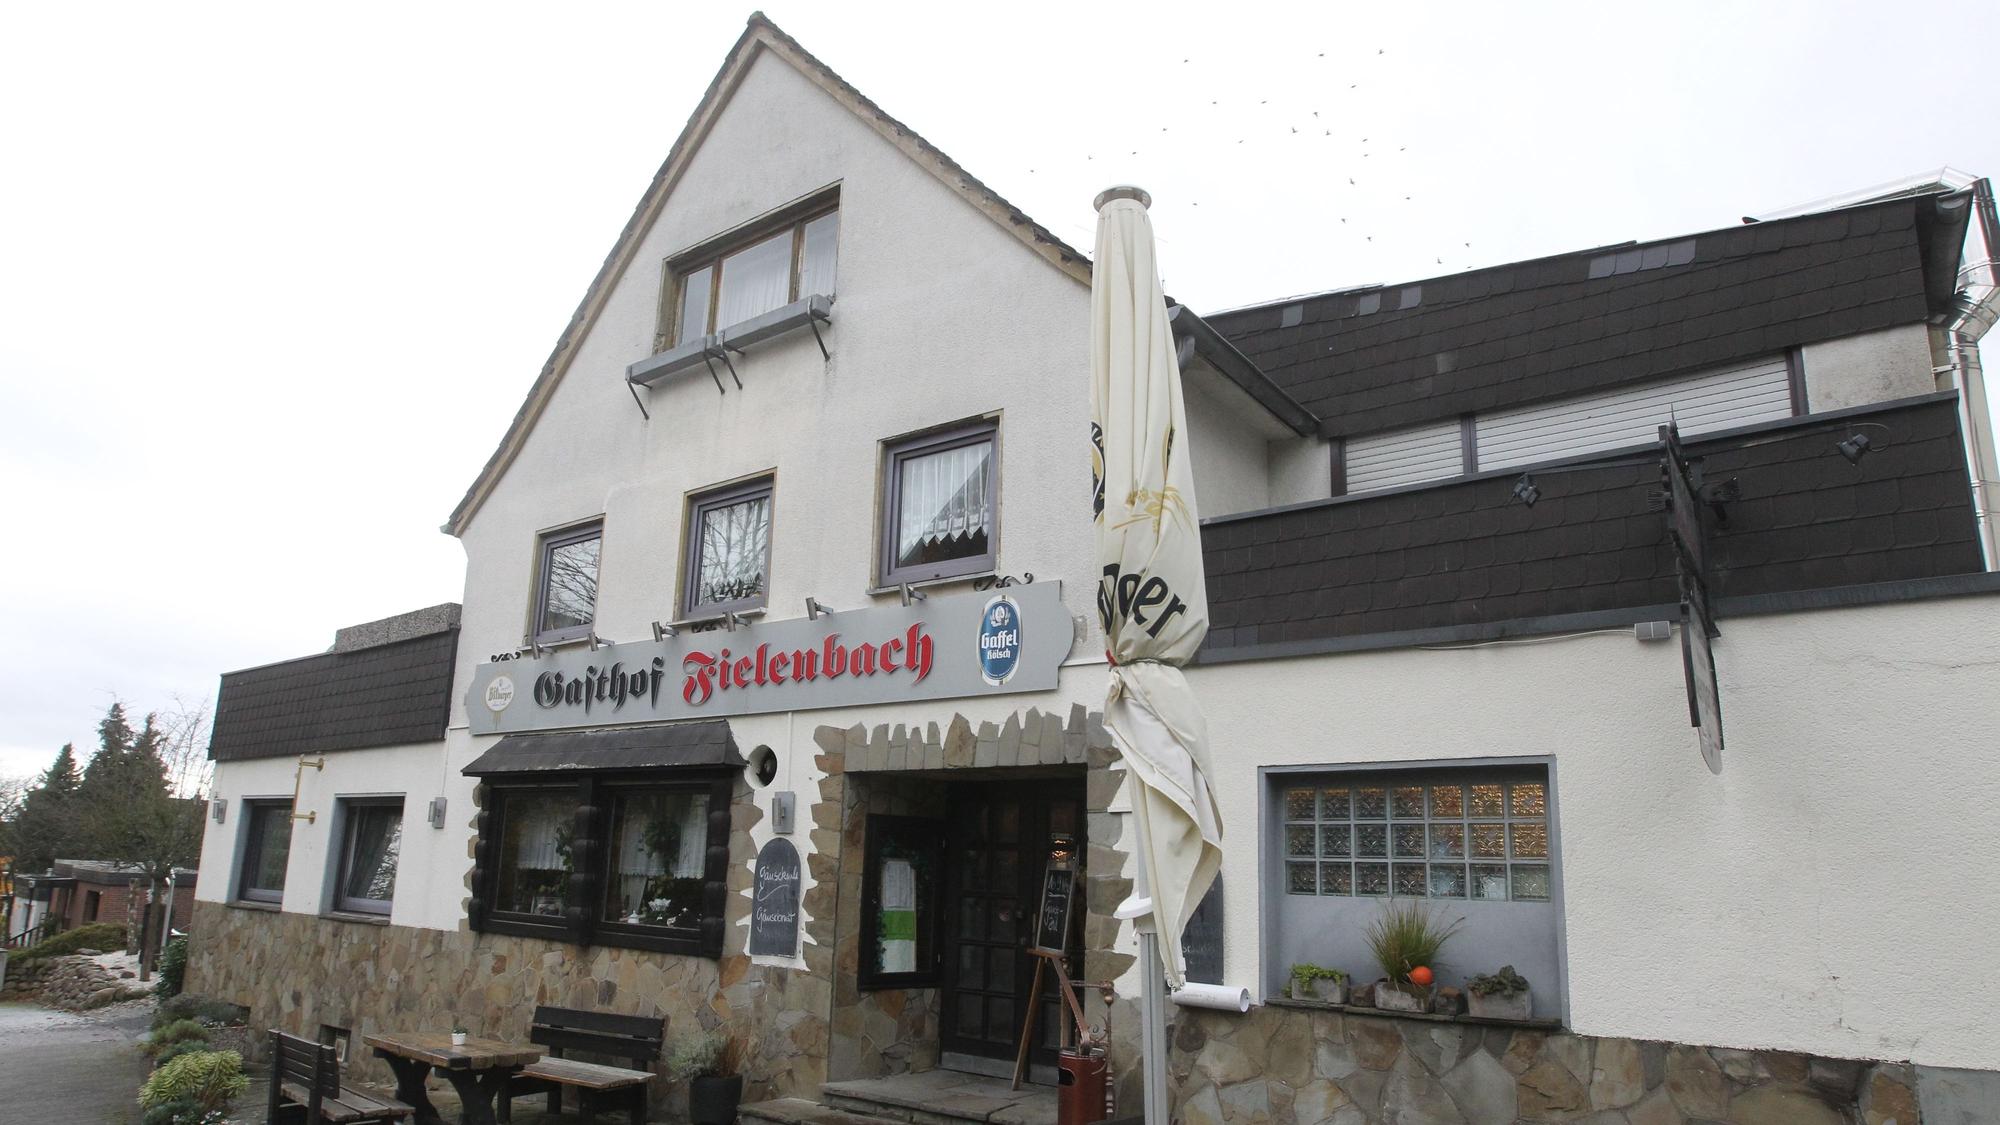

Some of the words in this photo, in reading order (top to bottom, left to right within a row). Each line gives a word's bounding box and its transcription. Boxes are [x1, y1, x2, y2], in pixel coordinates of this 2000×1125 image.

[981, 629, 1018, 649] Gaffel
[987, 648, 1011, 660] Kölsch
[533, 656, 664, 714] Gasthof
[682, 618, 935, 706] Fielenbach
